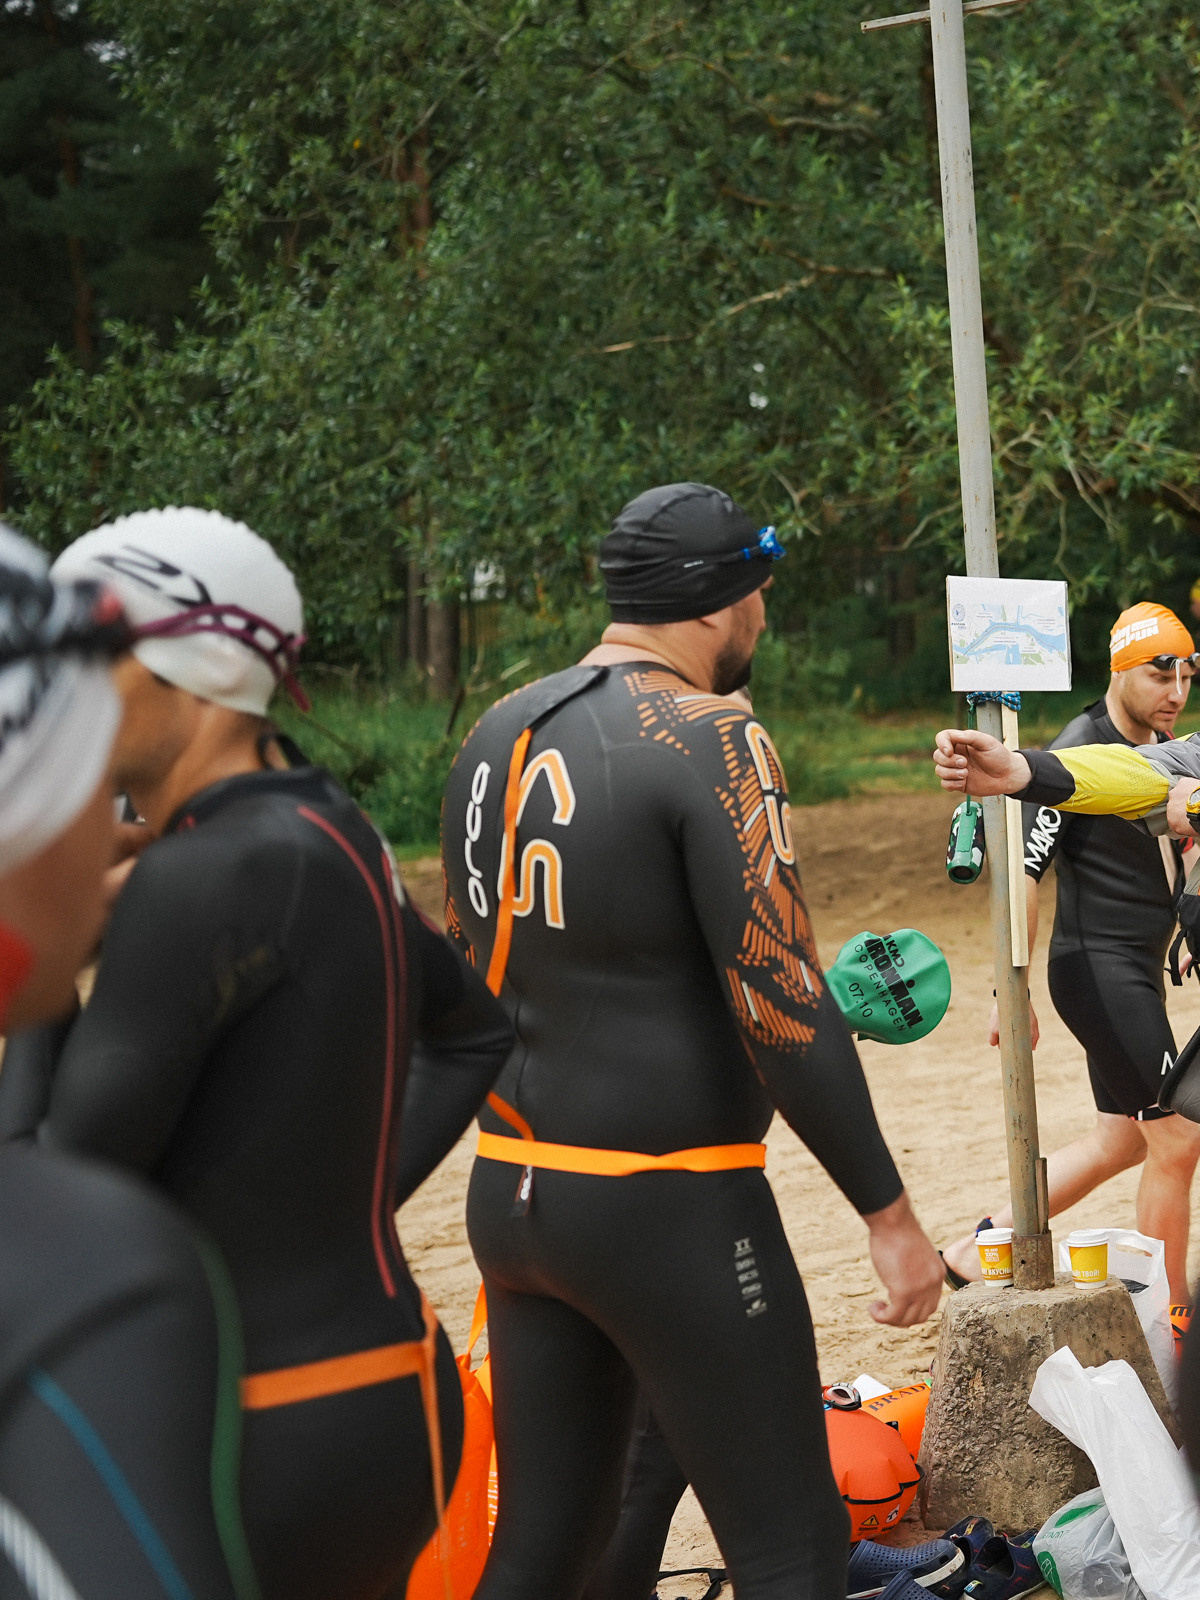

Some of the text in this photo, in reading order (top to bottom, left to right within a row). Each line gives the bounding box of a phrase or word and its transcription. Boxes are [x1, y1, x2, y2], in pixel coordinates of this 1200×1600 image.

[464, 761, 491, 918] orca
[1023, 805, 1061, 872] MAKO
[848, 982, 873, 1018] 07:10
[854, 944, 907, 1032] COPENHAGEN
[863, 938, 923, 1029] IRONMAN
